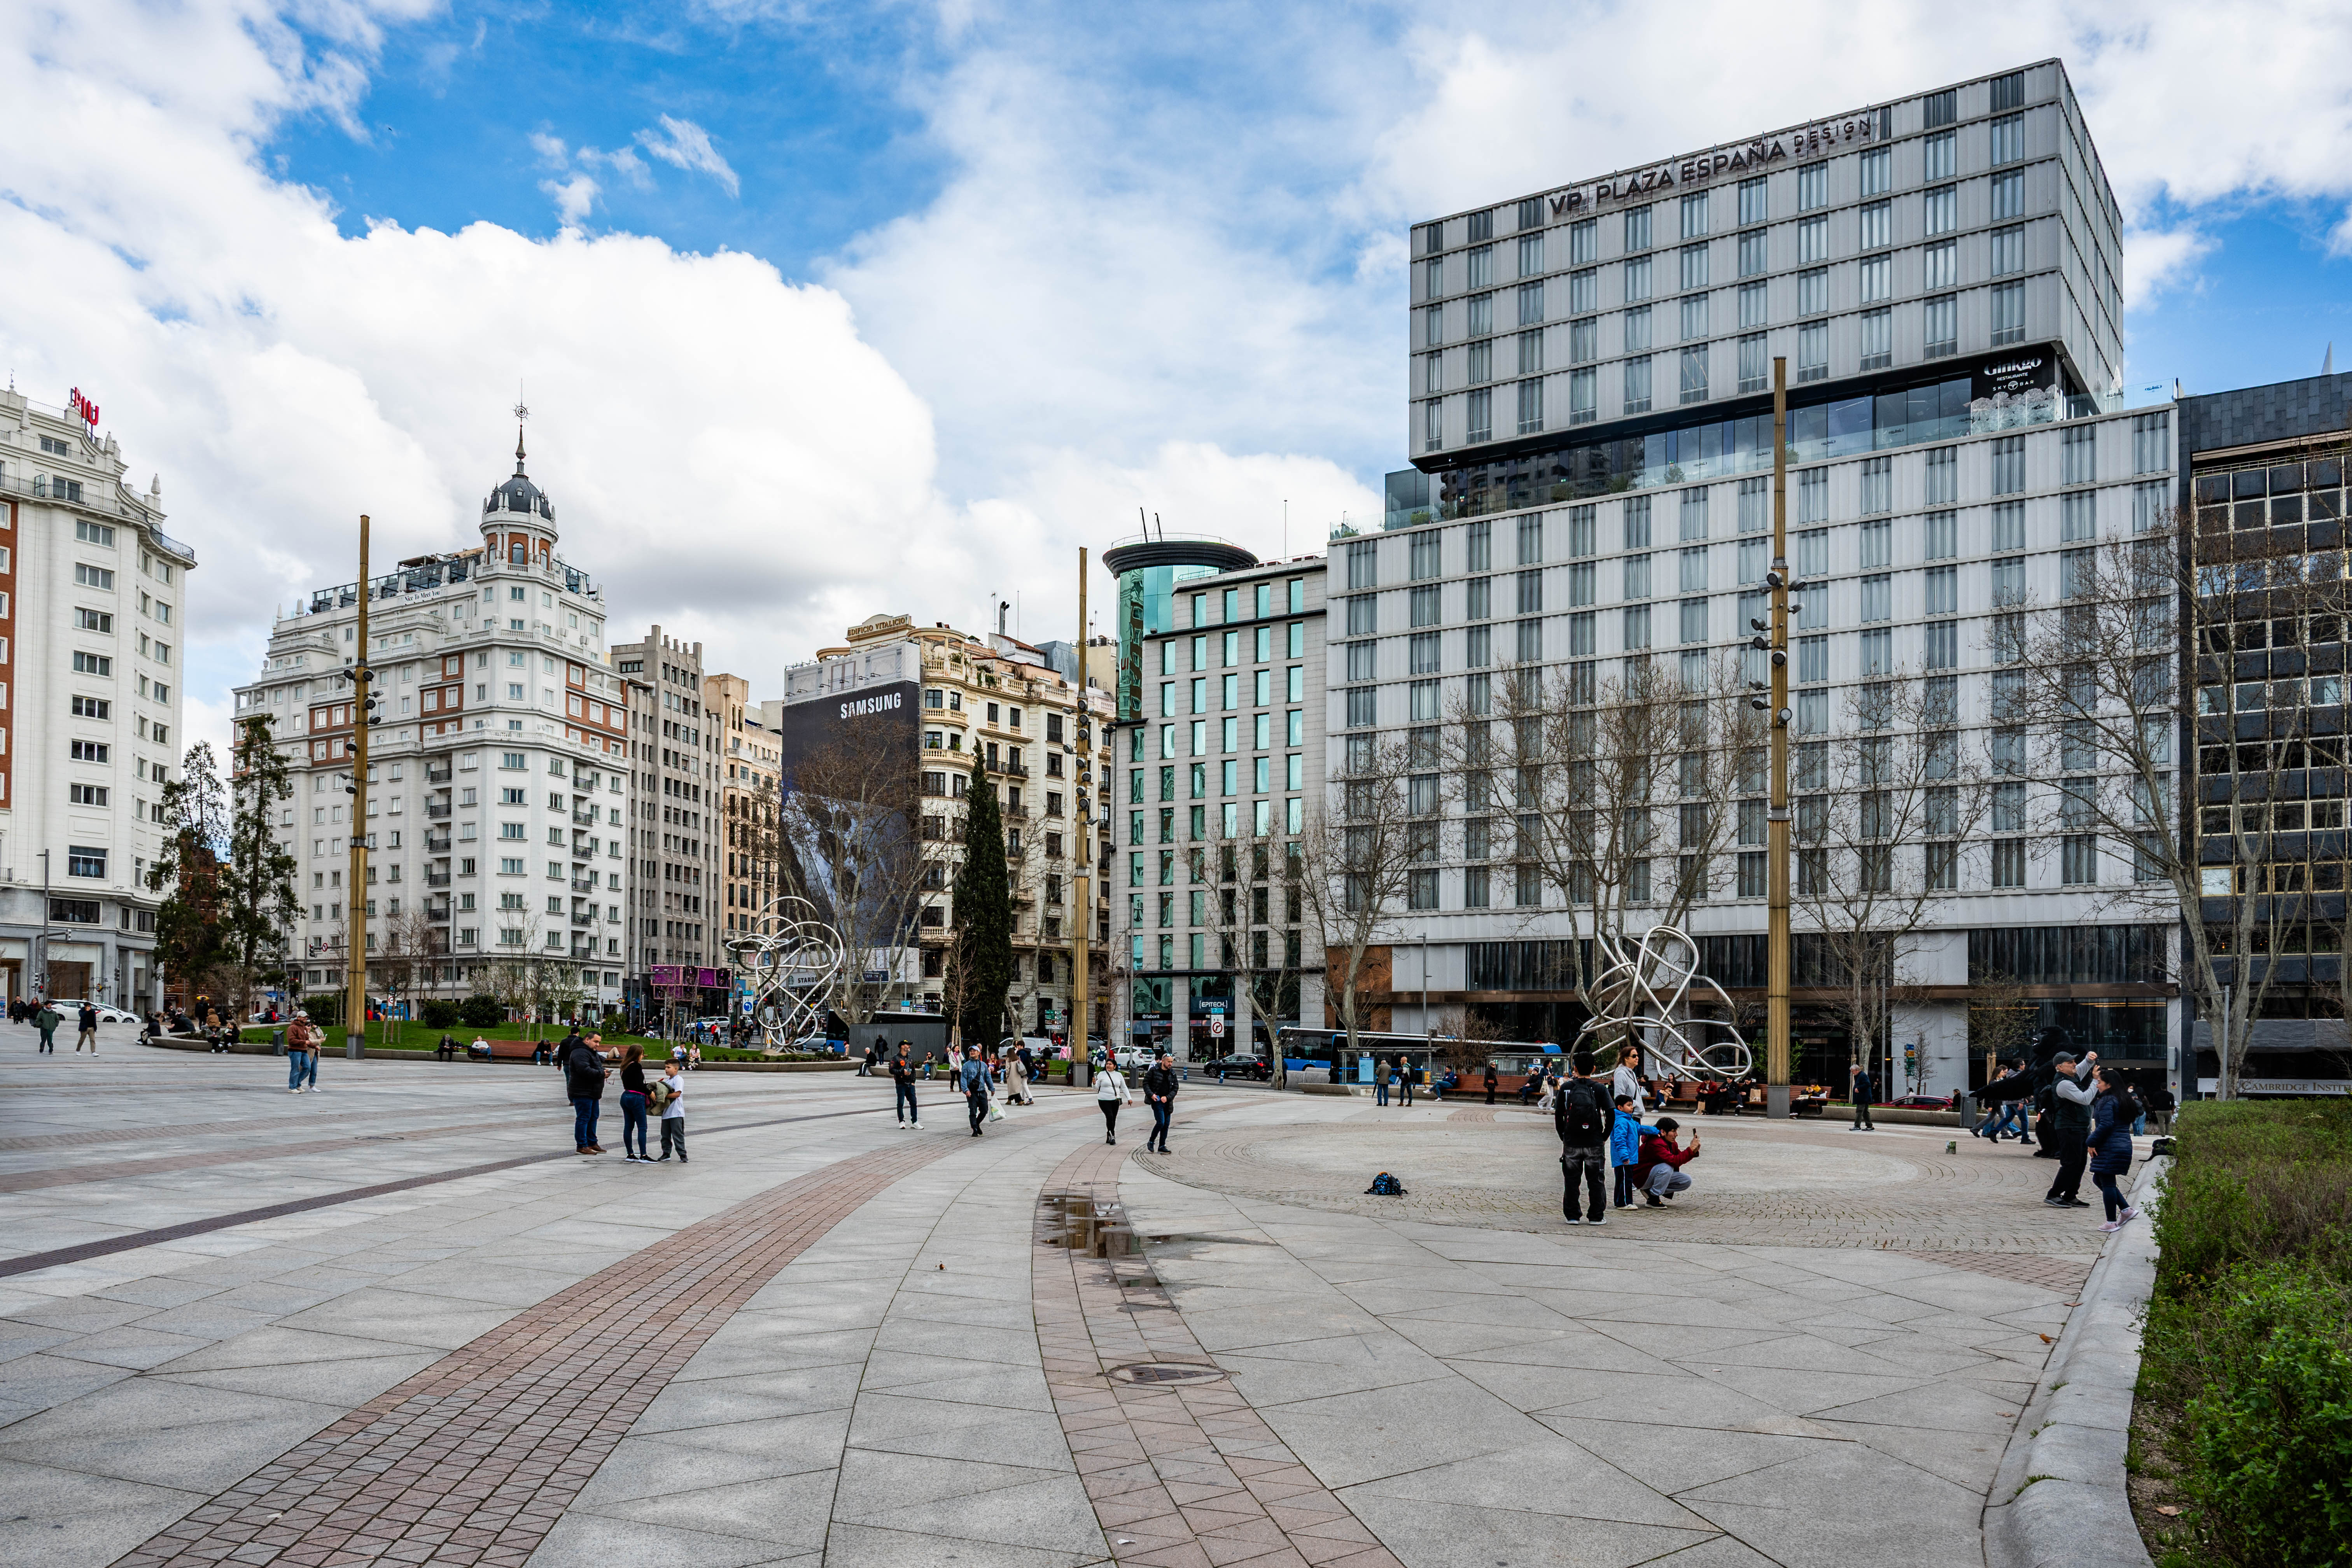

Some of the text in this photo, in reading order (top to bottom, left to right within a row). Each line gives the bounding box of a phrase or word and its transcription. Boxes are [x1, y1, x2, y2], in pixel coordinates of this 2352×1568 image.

[1549, 117, 1871, 214] VP PLAZA ESPAÑA DESIGN
[1984, 357, 2042, 375] Ginkgo
[1997, 372, 2028, 381] RESTAURANTE
[74, 387, 100, 426] RIU
[848, 618, 905, 636] EDIFICIO VITALICIO
[840, 692, 901, 719] SAMSUNG
[2241, 1081, 2308, 1091] CAMBRIDGE
